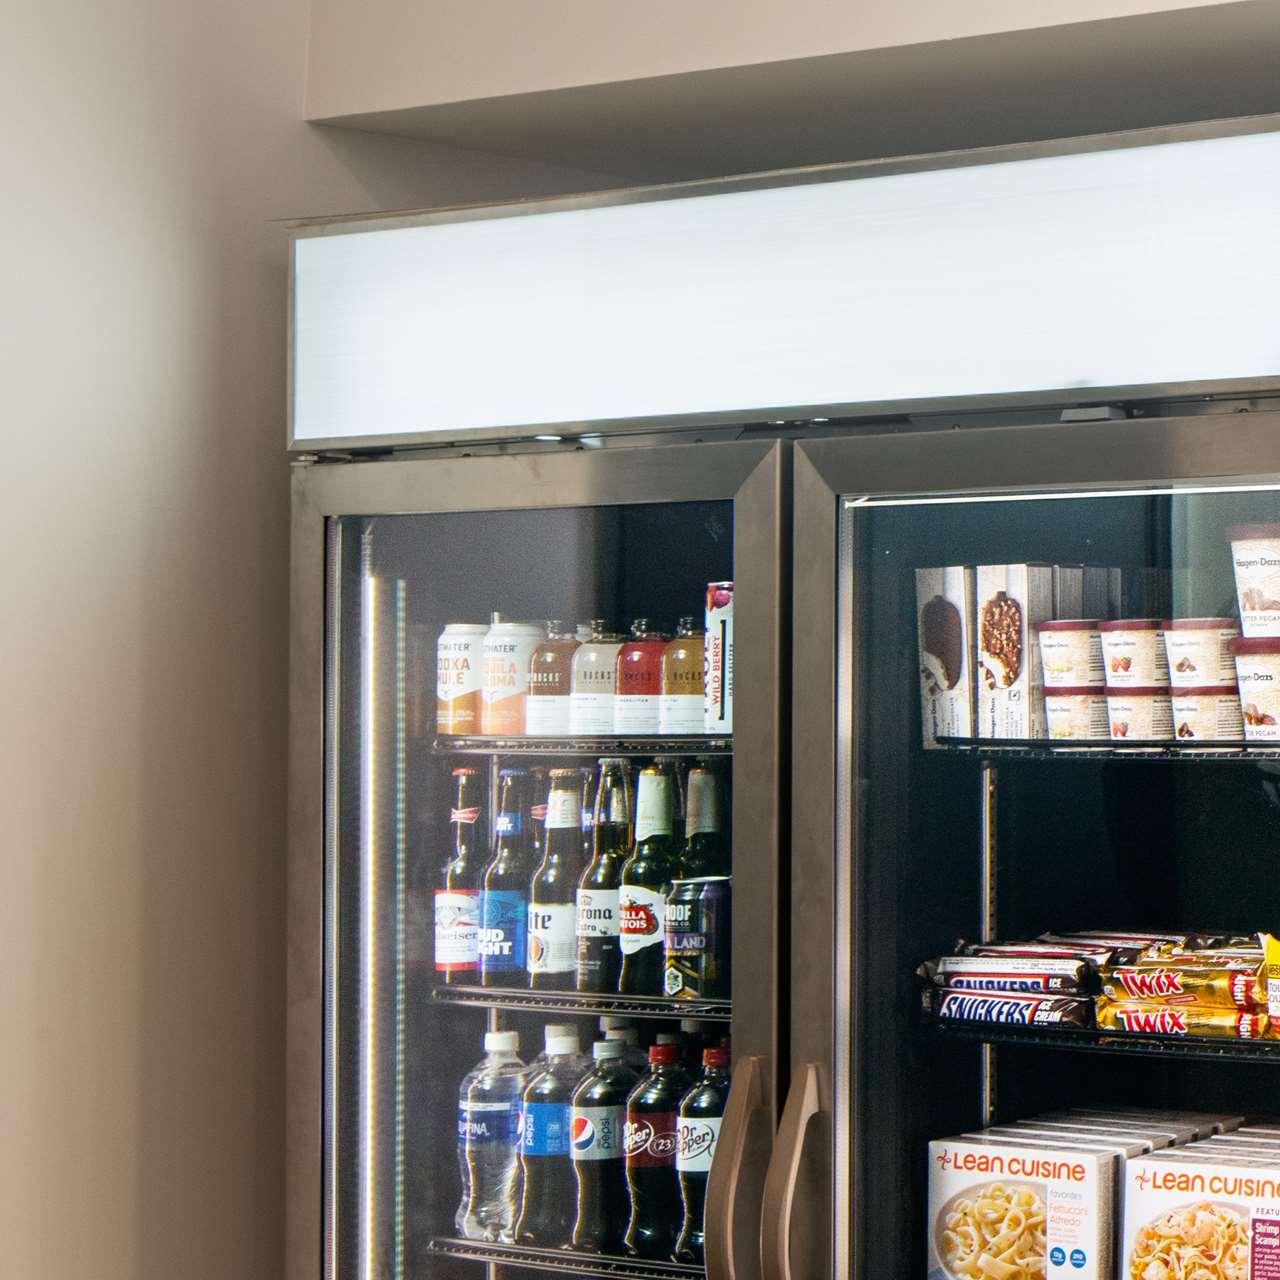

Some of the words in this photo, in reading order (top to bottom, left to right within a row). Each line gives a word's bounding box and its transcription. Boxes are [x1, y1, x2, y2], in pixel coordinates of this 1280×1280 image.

[712, 635, 721, 669] BERRY
[712, 671, 721, 705] WILD
[1114, 969, 1183, 999] Twix
[1034, 1011, 1061, 1022] CREAM
[1117, 1009, 1186, 1034] Twix
[525, 1114, 534, 1146] pepsi
[600, 1117, 611, 1149] pepsi
[953, 1151, 1004, 1174] Lean
[1151, 1171, 1205, 1193] Lean
[1255, 1222, 1280, 1235] Shrimp
[1255, 1234, 1280, 1246] Scampi
